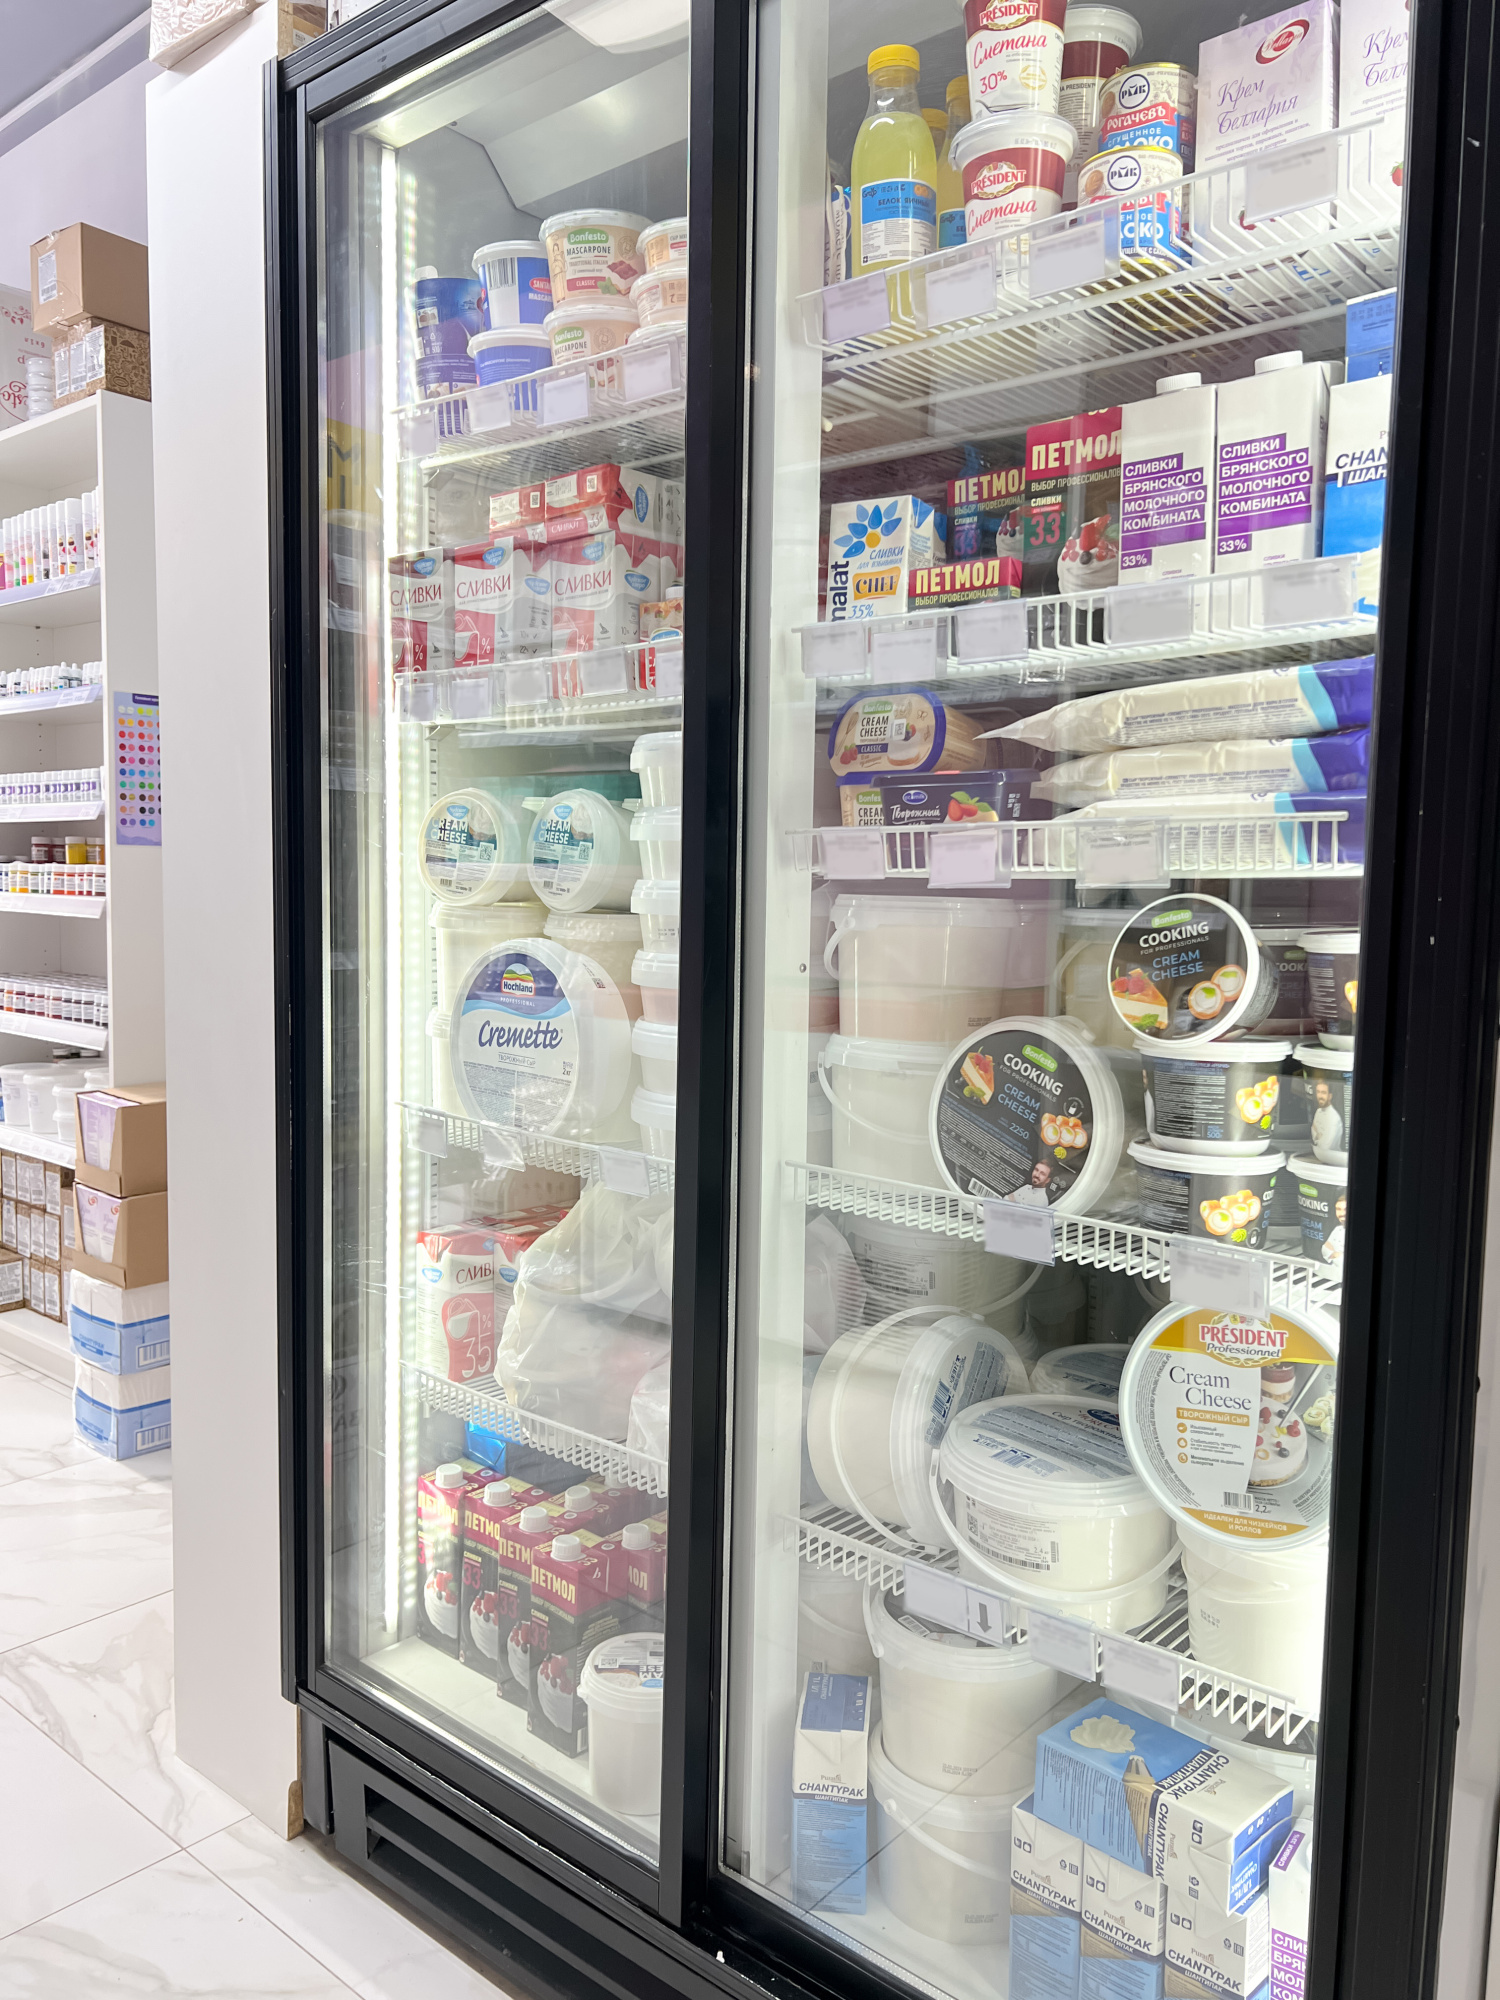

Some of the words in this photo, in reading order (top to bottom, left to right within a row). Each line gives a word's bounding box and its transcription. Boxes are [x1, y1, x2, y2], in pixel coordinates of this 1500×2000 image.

[980, 3, 1038, 26] PRÉSIDENT
[974, 34, 1047, 69] Сметана
[980, 70, 1007, 94] 30%
[1217, 77, 1264, 109] Крем
[1218, 95, 1298, 135] Беллария
[971, 170, 1026, 195] PRÉSIDENT
[967, 200, 1037, 236] Сметана
[569, 231, 607, 242] Bonfesto
[566, 245, 611, 256] MASCARPONE
[576, 279, 595, 287] CLASSIC
[554, 328, 583, 342] Bonfesto
[554, 340, 587, 355] MASCARPONE
[1221, 438, 1280, 459] СЛИВКИ
[1124, 458, 1178, 477] СЛИВКИ
[1221, 451, 1307, 479] БРЯНСКОГО
[1031, 480, 1056, 492] ВЫБОР
[1124, 471, 1202, 496] БРЯНСКОГО
[1220, 470, 1310, 497] МОЛОЧНОГО
[954, 503, 976, 516] ВЫБОР
[1030, 494, 1062, 508] СЛИВКИ
[1124, 489, 1205, 513] МОЛОЧНОГО
[1220, 490, 1306, 516] КОМБИНАТА
[551, 521, 579, 533] СЛИВКИ
[954, 515, 978, 526] СЛИВКИ
[1029, 511, 1062, 546] 33
[1123, 507, 1201, 531] КОМБИНАТА
[870, 546, 904, 560] СЛИВКИ
[1219, 539, 1247, 553] 33%
[1122, 553, 1147, 568] 33%
[456, 573, 511, 599] СЛИВКИ
[554, 569, 612, 596] СЛИВКИ
[916, 560, 1000, 594] ПЕТМОЛ
[391, 583, 442, 607] СЛИВКИ
[915, 592, 938, 606] ВЫБОР
[939, 587, 999, 604] ПРОФЕССИОНАЛОВ
[848, 603, 874, 619] 35%
[481, 637, 490, 653] %
[860, 726, 887, 738] CHEESE
[861, 716, 889, 727] CREAM
[861, 744, 882, 753] CLASSIC
[890, 805, 940, 822] Творожный
[432, 818, 469, 833] CREAM
[540, 818, 571, 833] CREAM
[430, 829, 467, 844] CHEESE
[538, 829, 570, 844] CHEESE
[1154, 912, 1190, 926] Bonfesto
[1139, 922, 1209, 948] COOKING
[1155, 936, 1209, 953] PROFESSIONALS
[1153, 950, 1200, 969] CREAM
[1151, 962, 1204, 982] CHEESE
[503, 981, 533, 994] Hochland
[500, 997, 536, 1007] PROFESSIONAL
[478, 1020, 563, 1050] Cremette
[498, 1053, 526, 1064] ТВОРОЖНЫЙ
[1025, 1047, 1055, 1069] Bonfesto
[1003, 1053, 1063, 1095] COOKING
[1004, 1083, 1041, 1111] CREAM
[998, 1094, 1038, 1124] CHEESE
[483, 1313, 492, 1328] %
[1200, 1324, 1287, 1348] PRÉSIDENT
[461, 1338, 492, 1378] 35
[1206, 1342, 1281, 1358] Professionnel
[1169, 1366, 1230, 1389] Cream
[1185, 1387, 1252, 1410] Cheese
[1178, 1409, 1231, 1422] ТВОРОЖНЫЙ
[1231, 1415, 1248, 1424] СЫР
[464, 1510, 500, 1540] ПЕТМО
[1204, 1513, 1233, 1523] ИДЕАЛЕН
[1234, 1518, 1247, 1526] ДЛЯ
[1248, 1520, 1287, 1531] ЧИЗКЕЙКОВ
[1234, 1524, 1262, 1535] РОЛЛОВ
[499, 1538, 532, 1564] ПЕТМ
[531, 1564, 576, 1604] ПЕТМОЛ
[1158, 1753, 1209, 1789] ШАНТИПАК
[1167, 1754, 1230, 1801] CHANTYPAK
[799, 1782, 864, 1797] CHANTYPAK
[815, 1794, 849, 1803] ШАНТИПАК
[1155, 1803, 1169, 1881] CHANTYPAK
[1278, 1845, 1294, 1867] СЛИВКИ
[1012, 1869, 1076, 1908] CHANTYPAK
[1026, 1889, 1060, 1910] ШАНТИПАК
[1083, 1910, 1152, 1952] CHANTYPAK
[1098, 1931, 1134, 1953] ШАНТИПАК
[1168, 1948, 1241, 1992] CHANTYPAK
[1184, 1970, 1223, 1993] ШАНТИПАК
